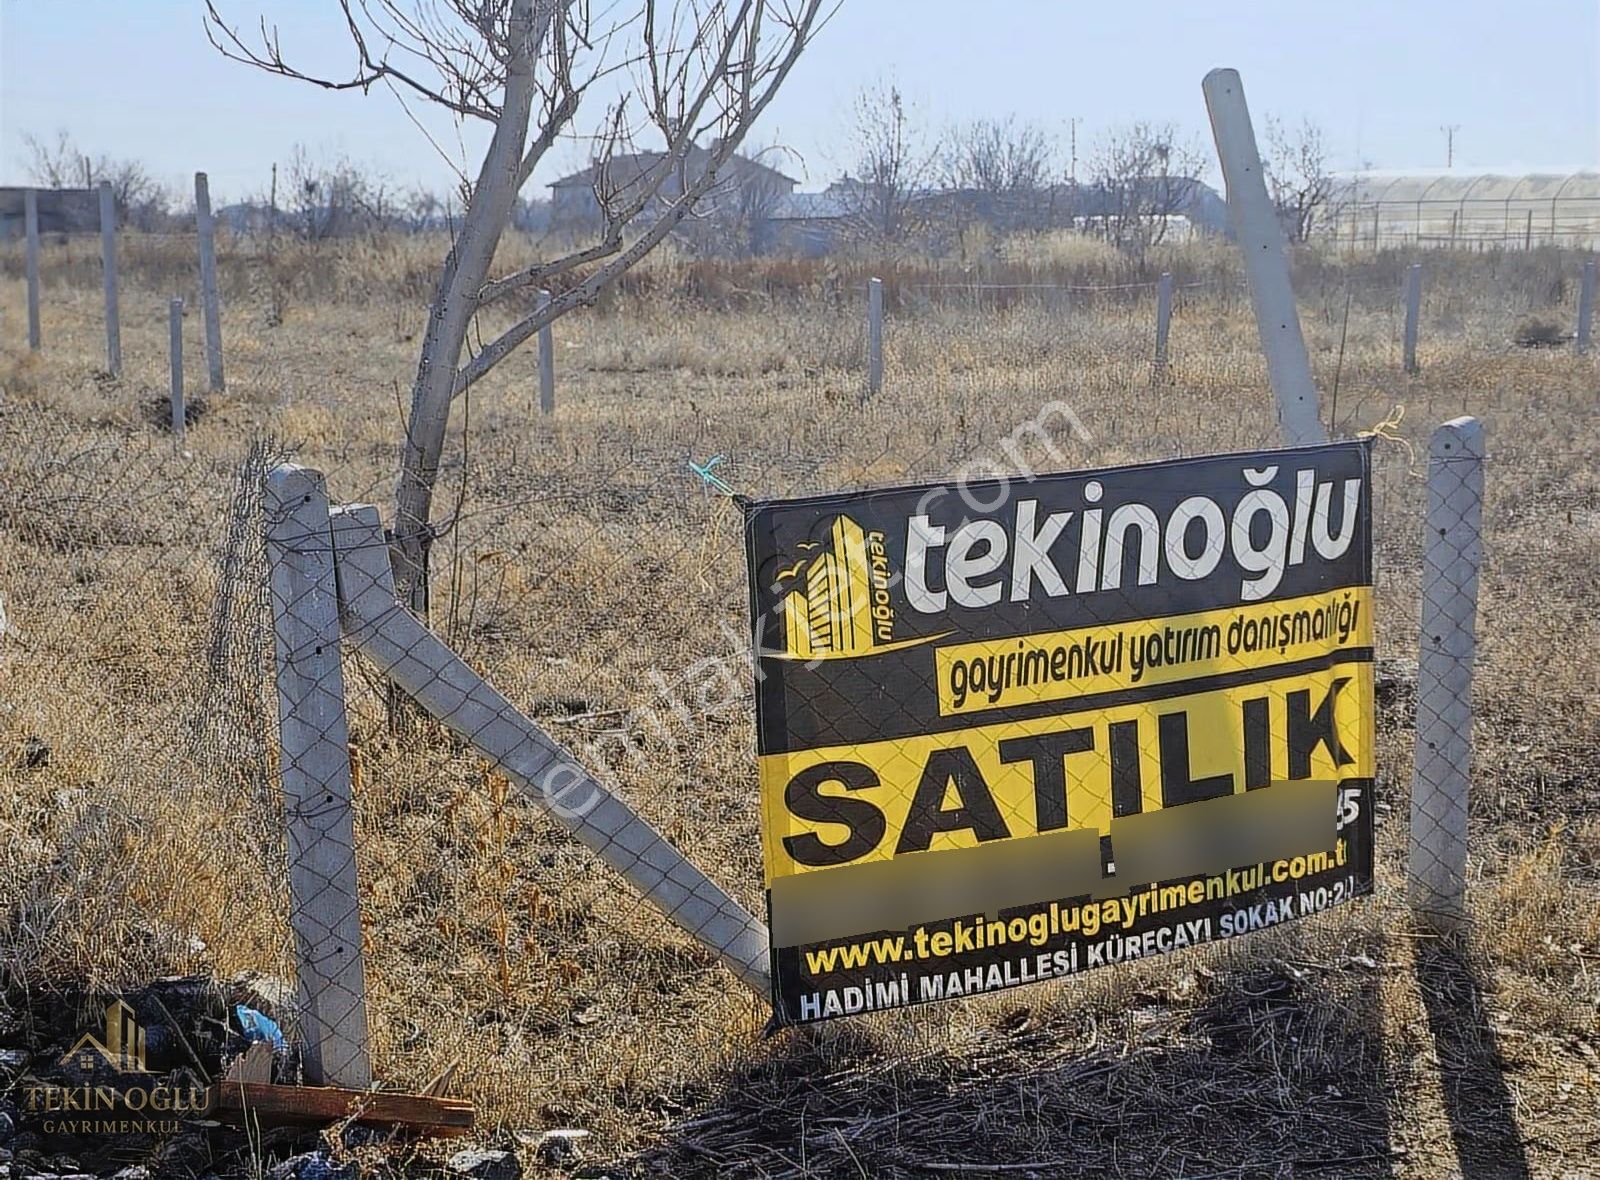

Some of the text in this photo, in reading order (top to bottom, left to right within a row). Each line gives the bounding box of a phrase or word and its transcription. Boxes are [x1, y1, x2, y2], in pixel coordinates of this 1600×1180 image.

[868, 530, 896, 640] tekinoğlu
[904, 465, 1361, 614] tekinoğlu
[950, 630, 1122, 704] gayrimenkul
[1128, 616, 1221, 673] yatırım
[783, 678, 1355, 867] SATILIK
[800, 972, 908, 1021] HADİMİ
[919, 943, 1078, 998] MAHALLESİ
[1219, 896, 1294, 939] SOKAK
[806, 837, 1347, 975] www.tekinoglugayrimenkul.com.t
